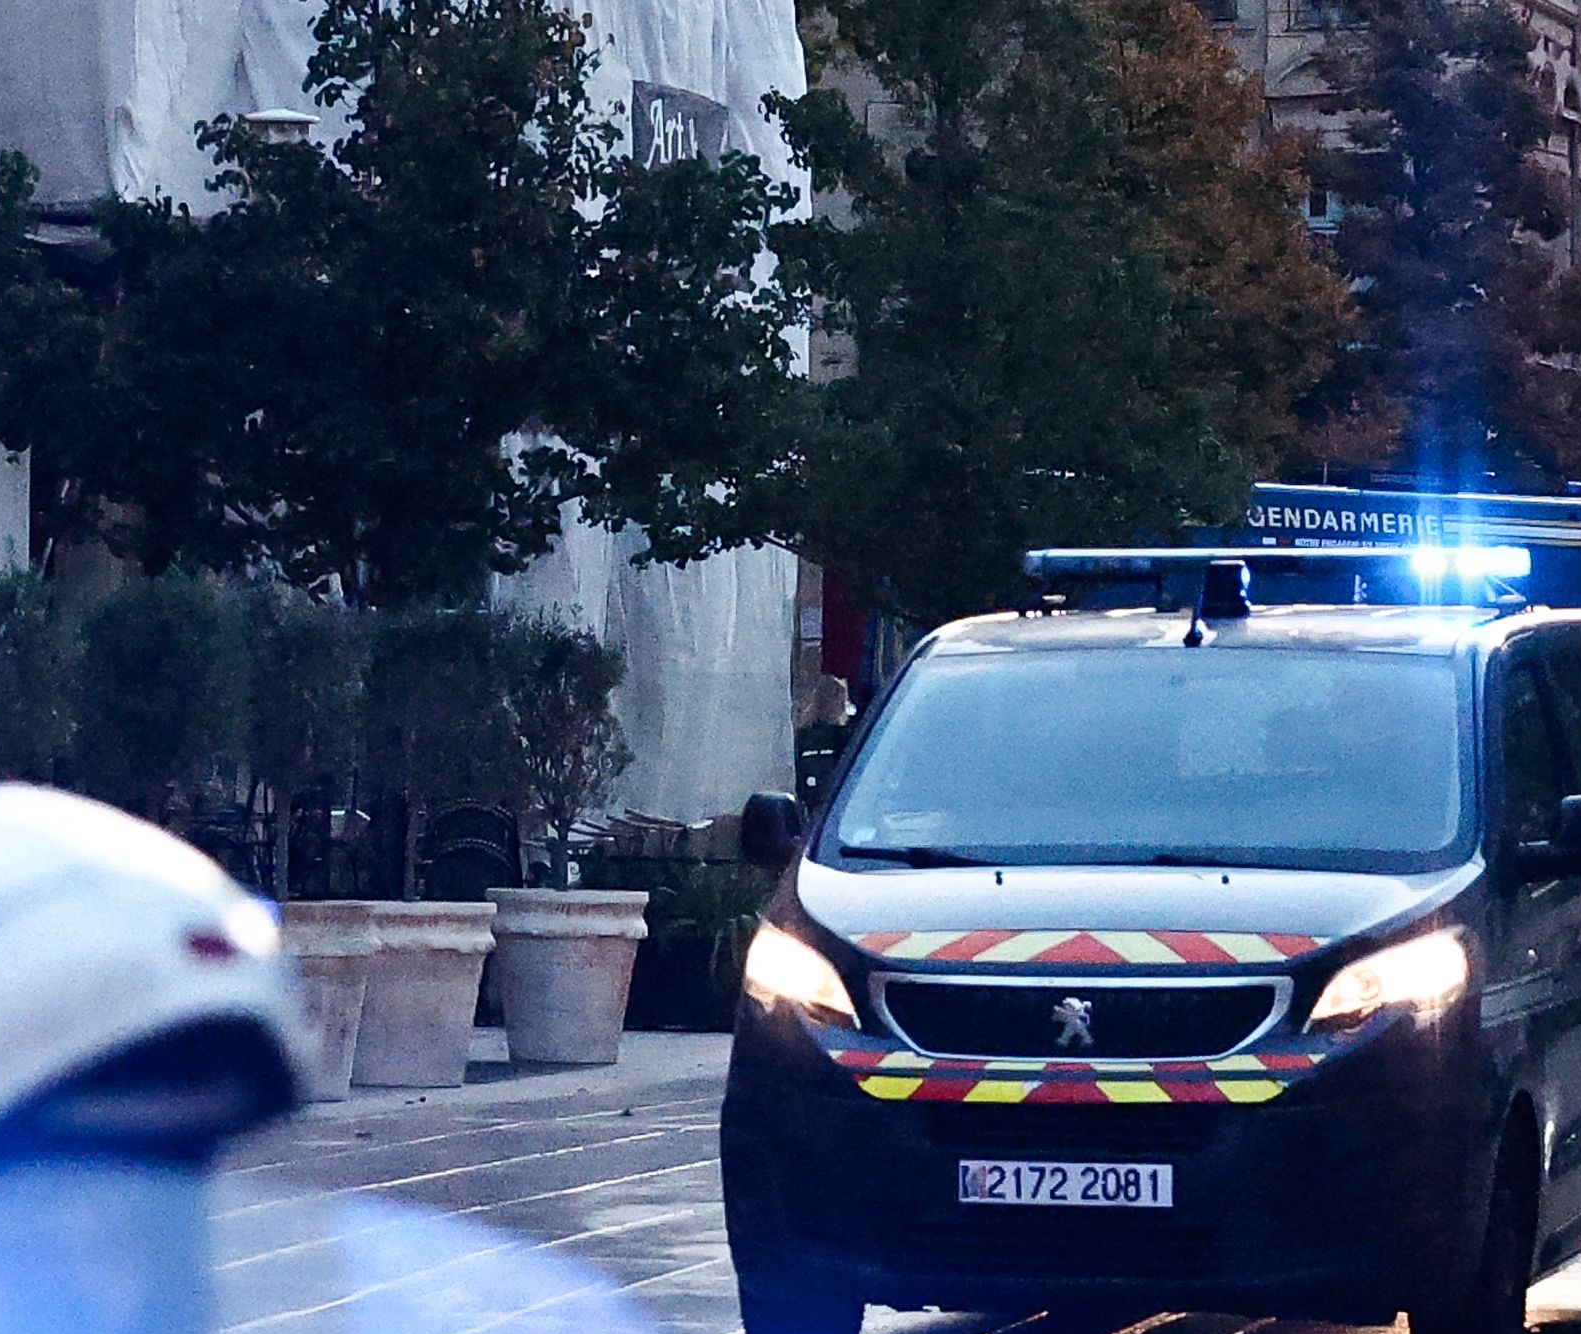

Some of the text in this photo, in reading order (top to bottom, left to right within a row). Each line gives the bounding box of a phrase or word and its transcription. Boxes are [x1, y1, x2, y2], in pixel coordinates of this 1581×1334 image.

[1247, 505, 1440, 537] GENDARMERIE
[988, 1166, 1159, 1203] 2172 2081
